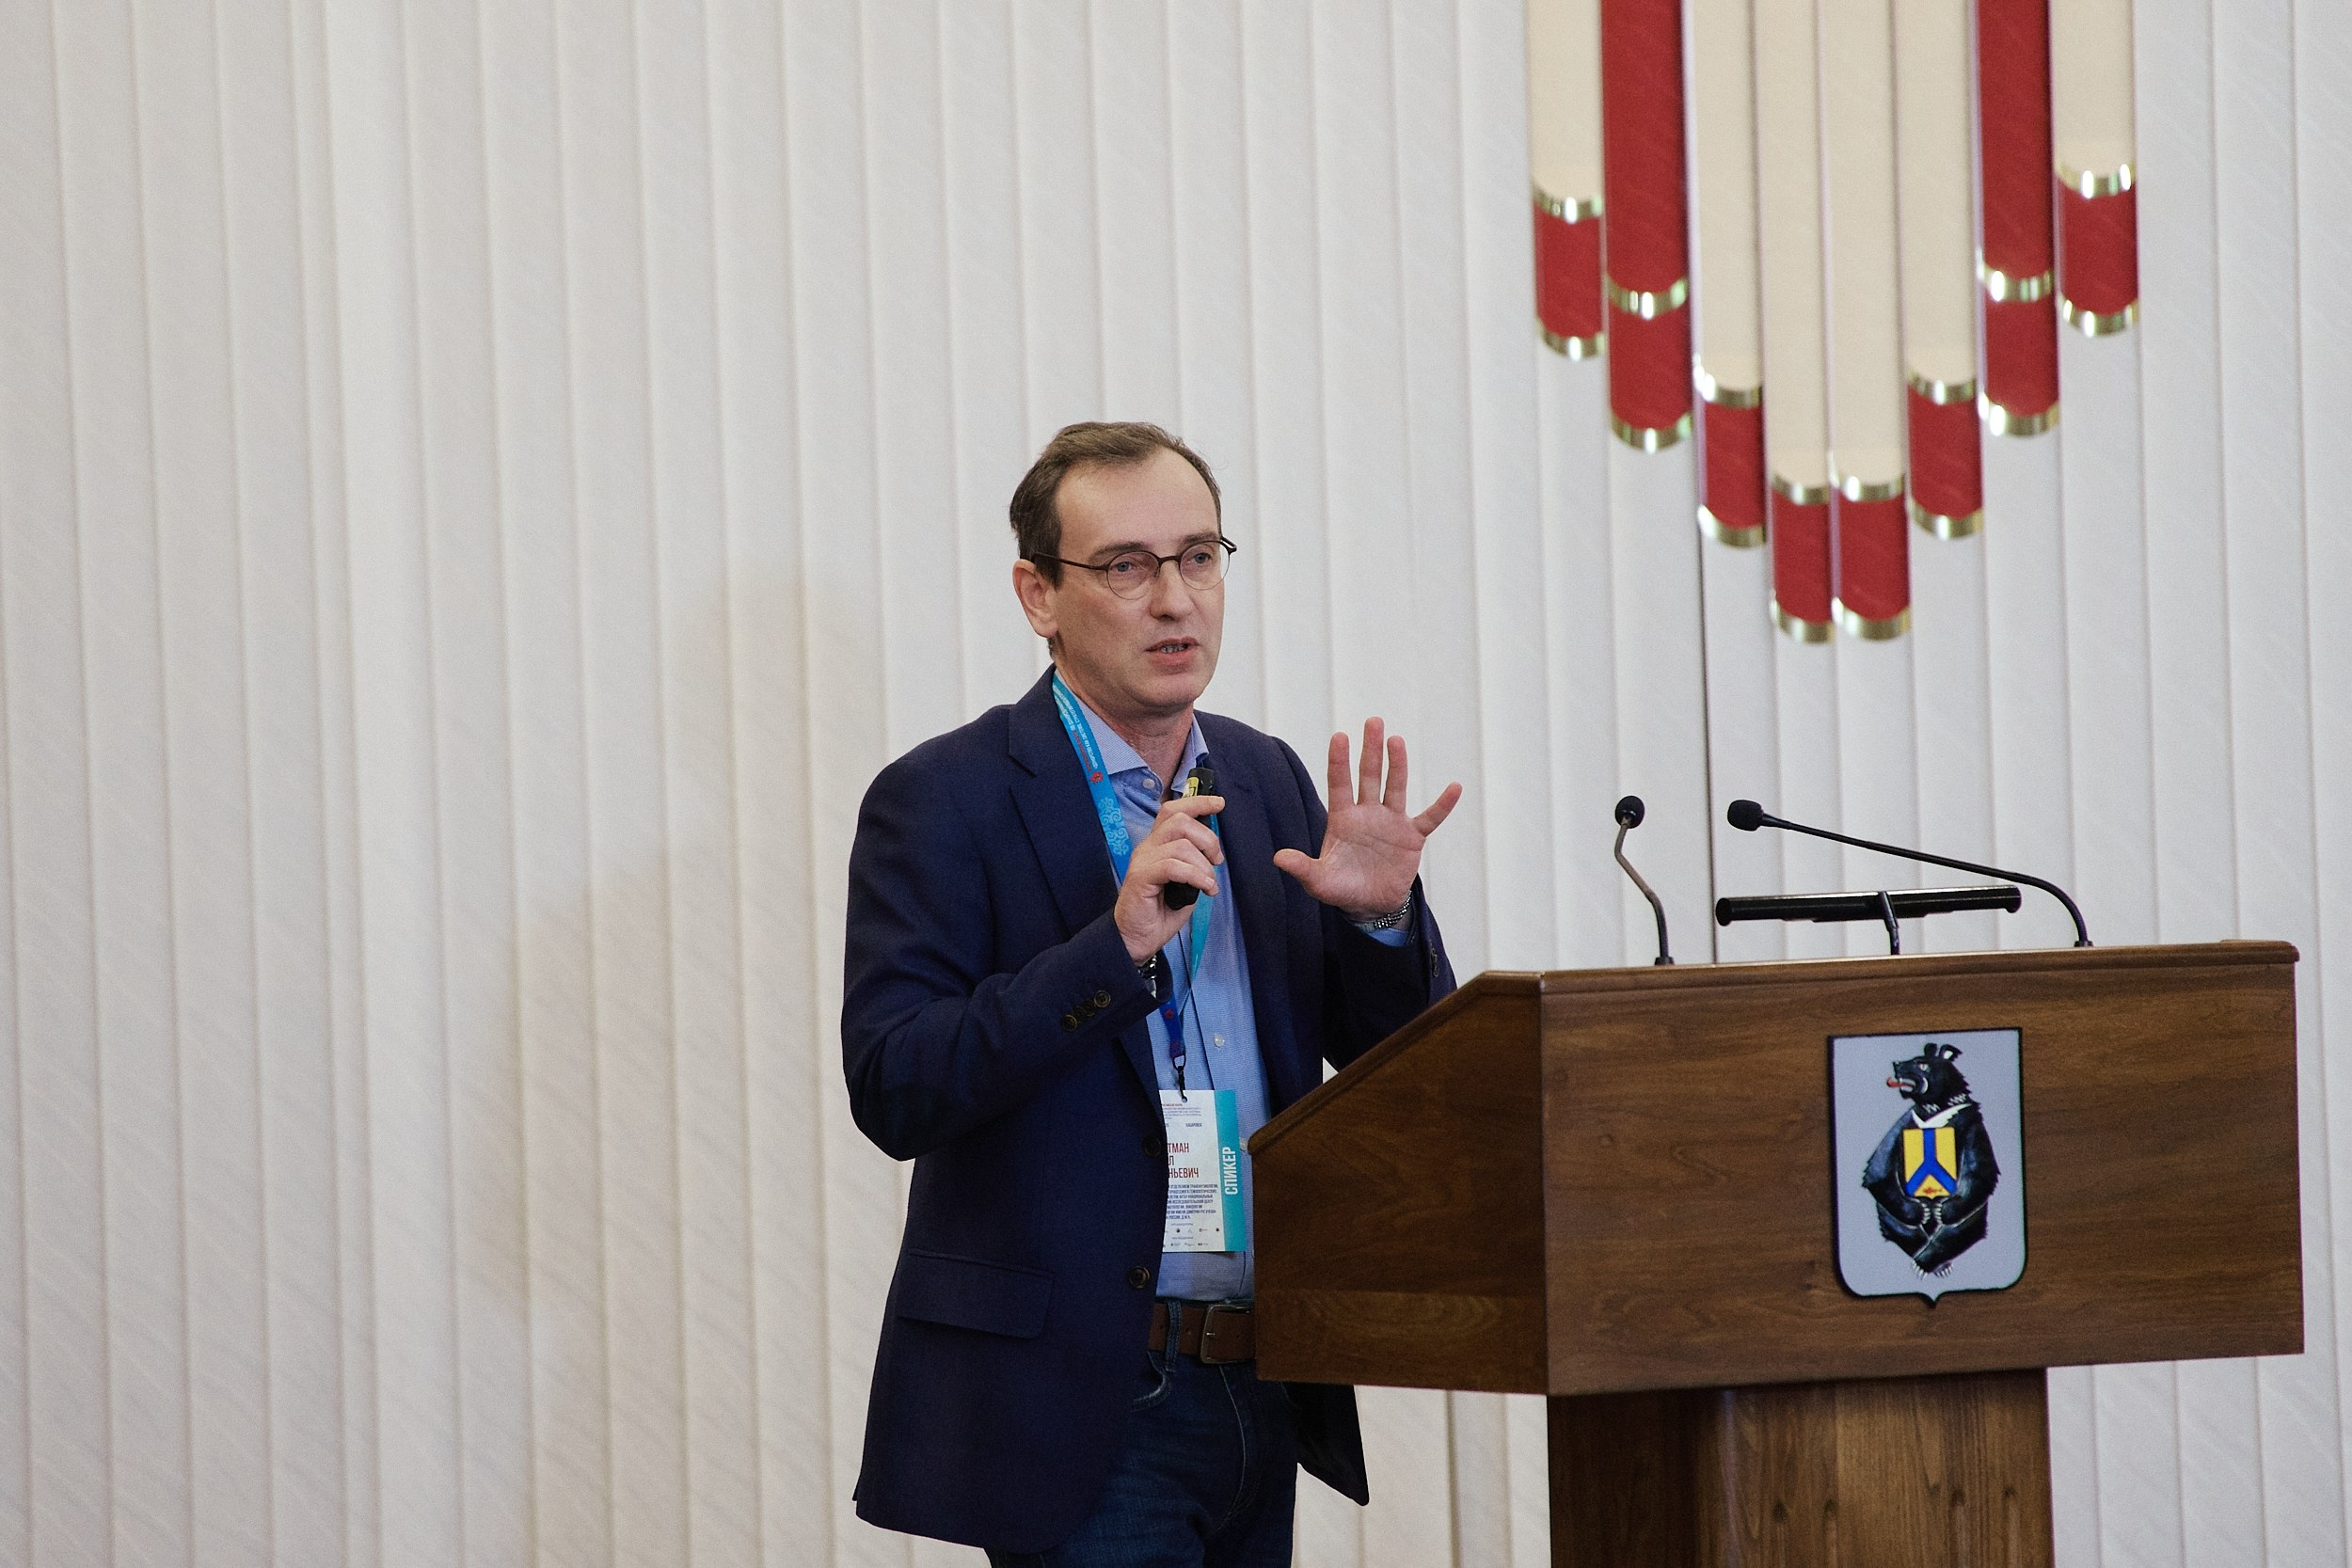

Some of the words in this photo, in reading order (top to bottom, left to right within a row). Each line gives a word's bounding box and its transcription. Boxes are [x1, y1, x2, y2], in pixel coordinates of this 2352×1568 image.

[1167, 1142, 1190, 1153] ТМАН
[1168, 1155, 1175, 1166] Л
[1168, 1167, 1200, 1179] НЬЕВИЧ
[1222, 1146, 1238, 1196] СПИКЕР
